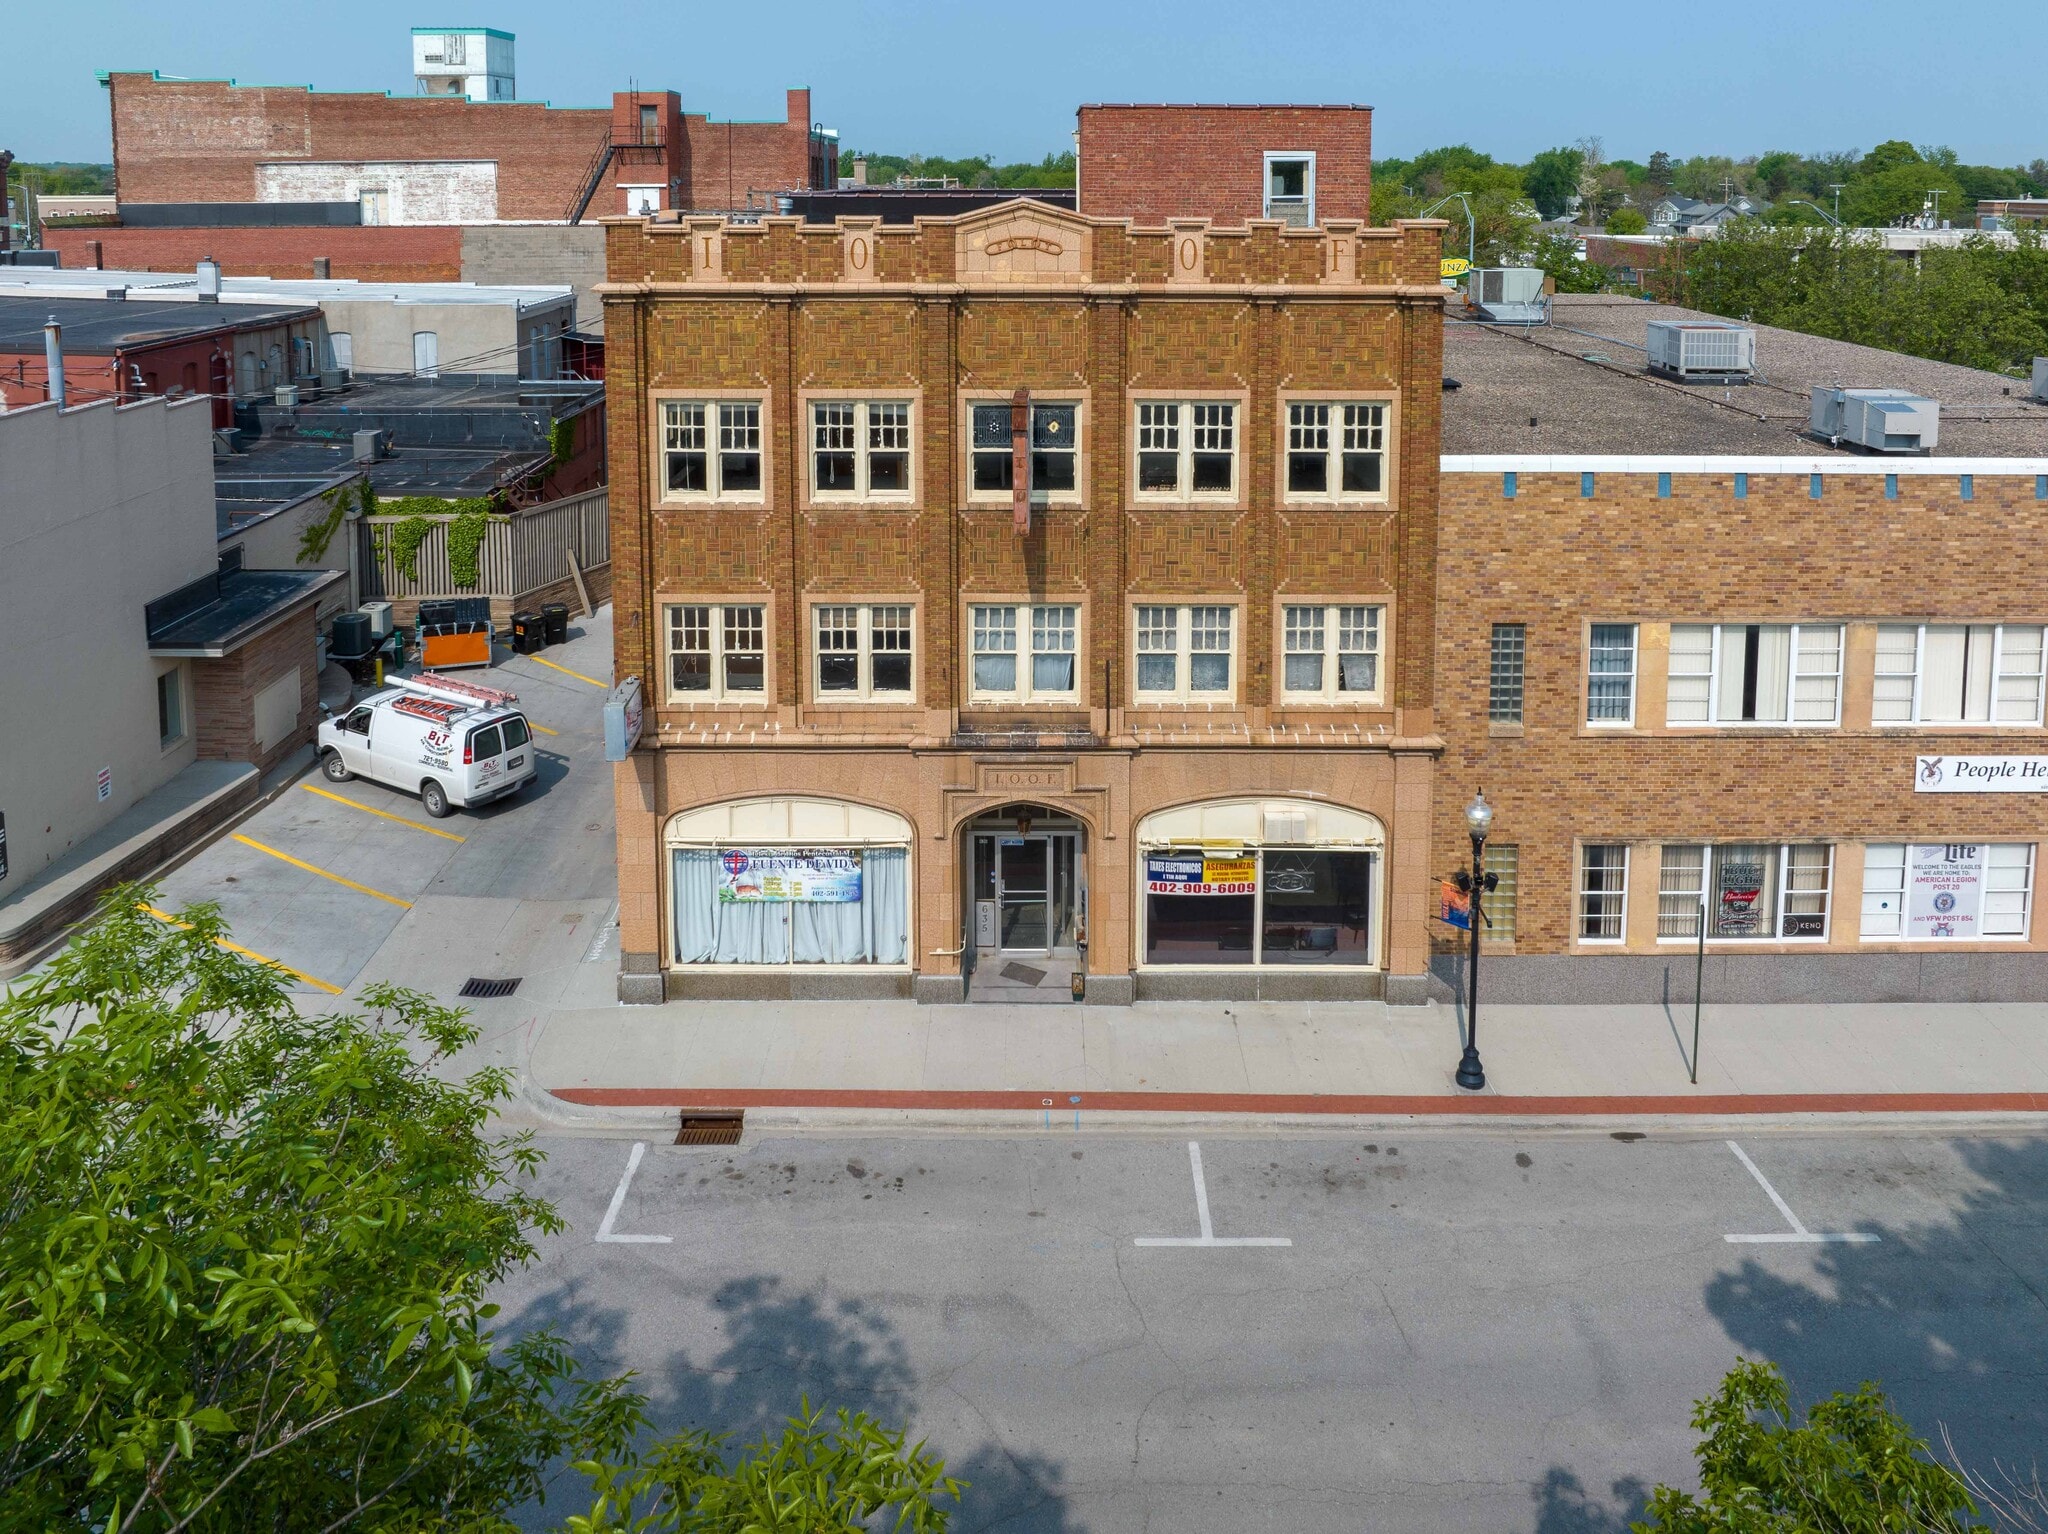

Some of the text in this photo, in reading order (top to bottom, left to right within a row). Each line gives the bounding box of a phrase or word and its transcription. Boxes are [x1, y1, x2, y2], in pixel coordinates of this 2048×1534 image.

[702, 237, 1348, 271] I O O F
[428, 730, 450, 746] BLT
[1954, 760, 2048, 782] People He
[1943, 844, 1977, 863] Lite
[752, 859, 857, 869] FUENTE DE VIDA
[1149, 860, 1202, 874] TAXES ELECTRONICOS
[1205, 861, 1256, 871] ASEGURANZAS
[1149, 882, 1256, 894] 402-909-6009
[1725, 892, 1756, 900] Budweiser
